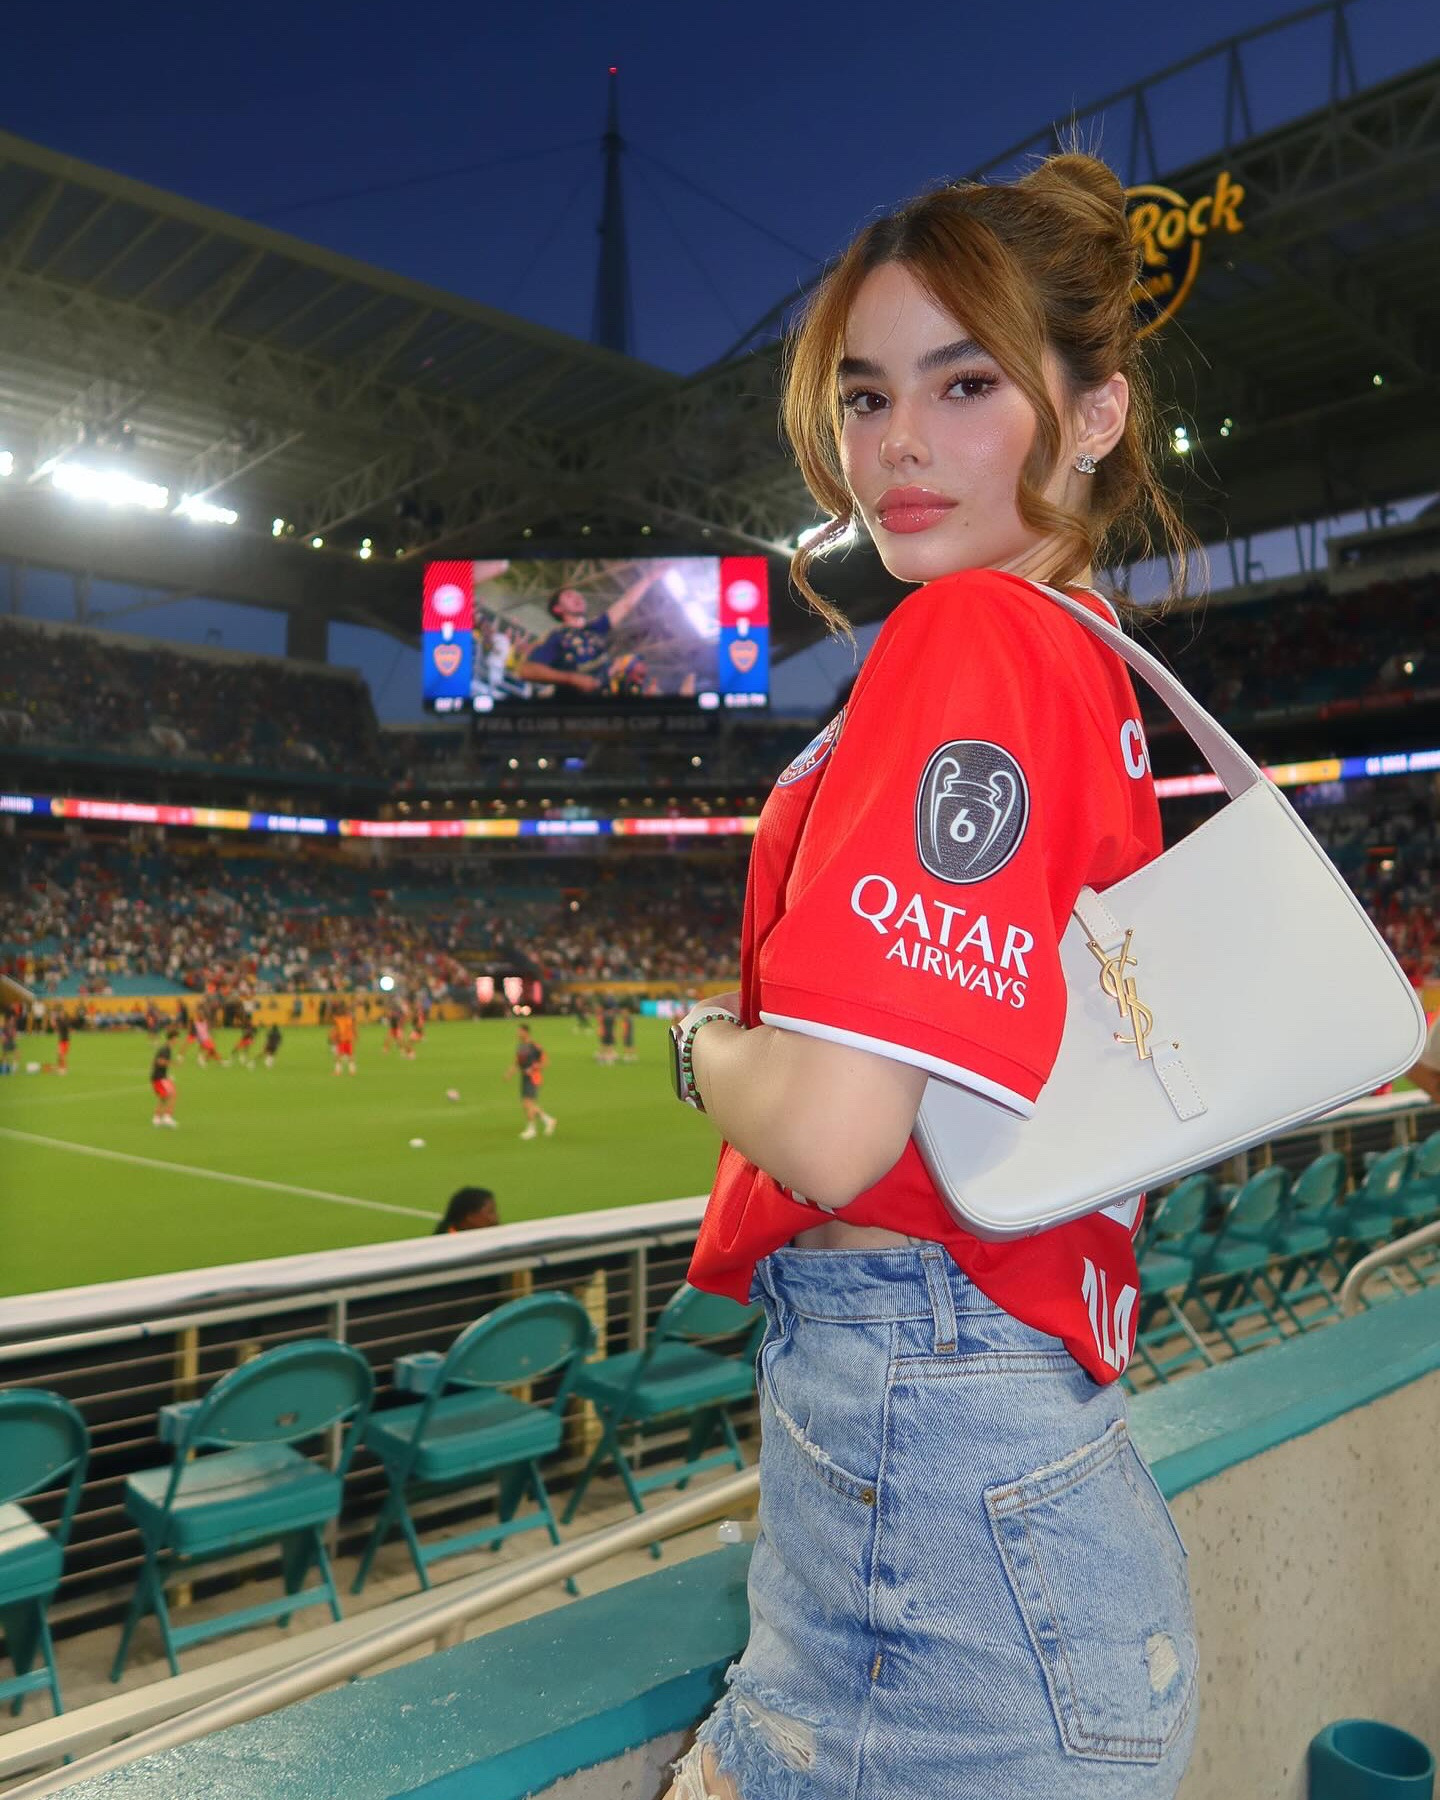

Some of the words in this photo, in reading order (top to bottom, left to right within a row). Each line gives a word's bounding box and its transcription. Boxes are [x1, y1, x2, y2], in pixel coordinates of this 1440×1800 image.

[1128, 171, 1244, 265] Rock
[949, 808, 976, 843] 6
[850, 874, 1034, 978] QATAR
[885, 937, 1027, 1009] AIRWAYS
[1085, 929, 1153, 1060] YSL
